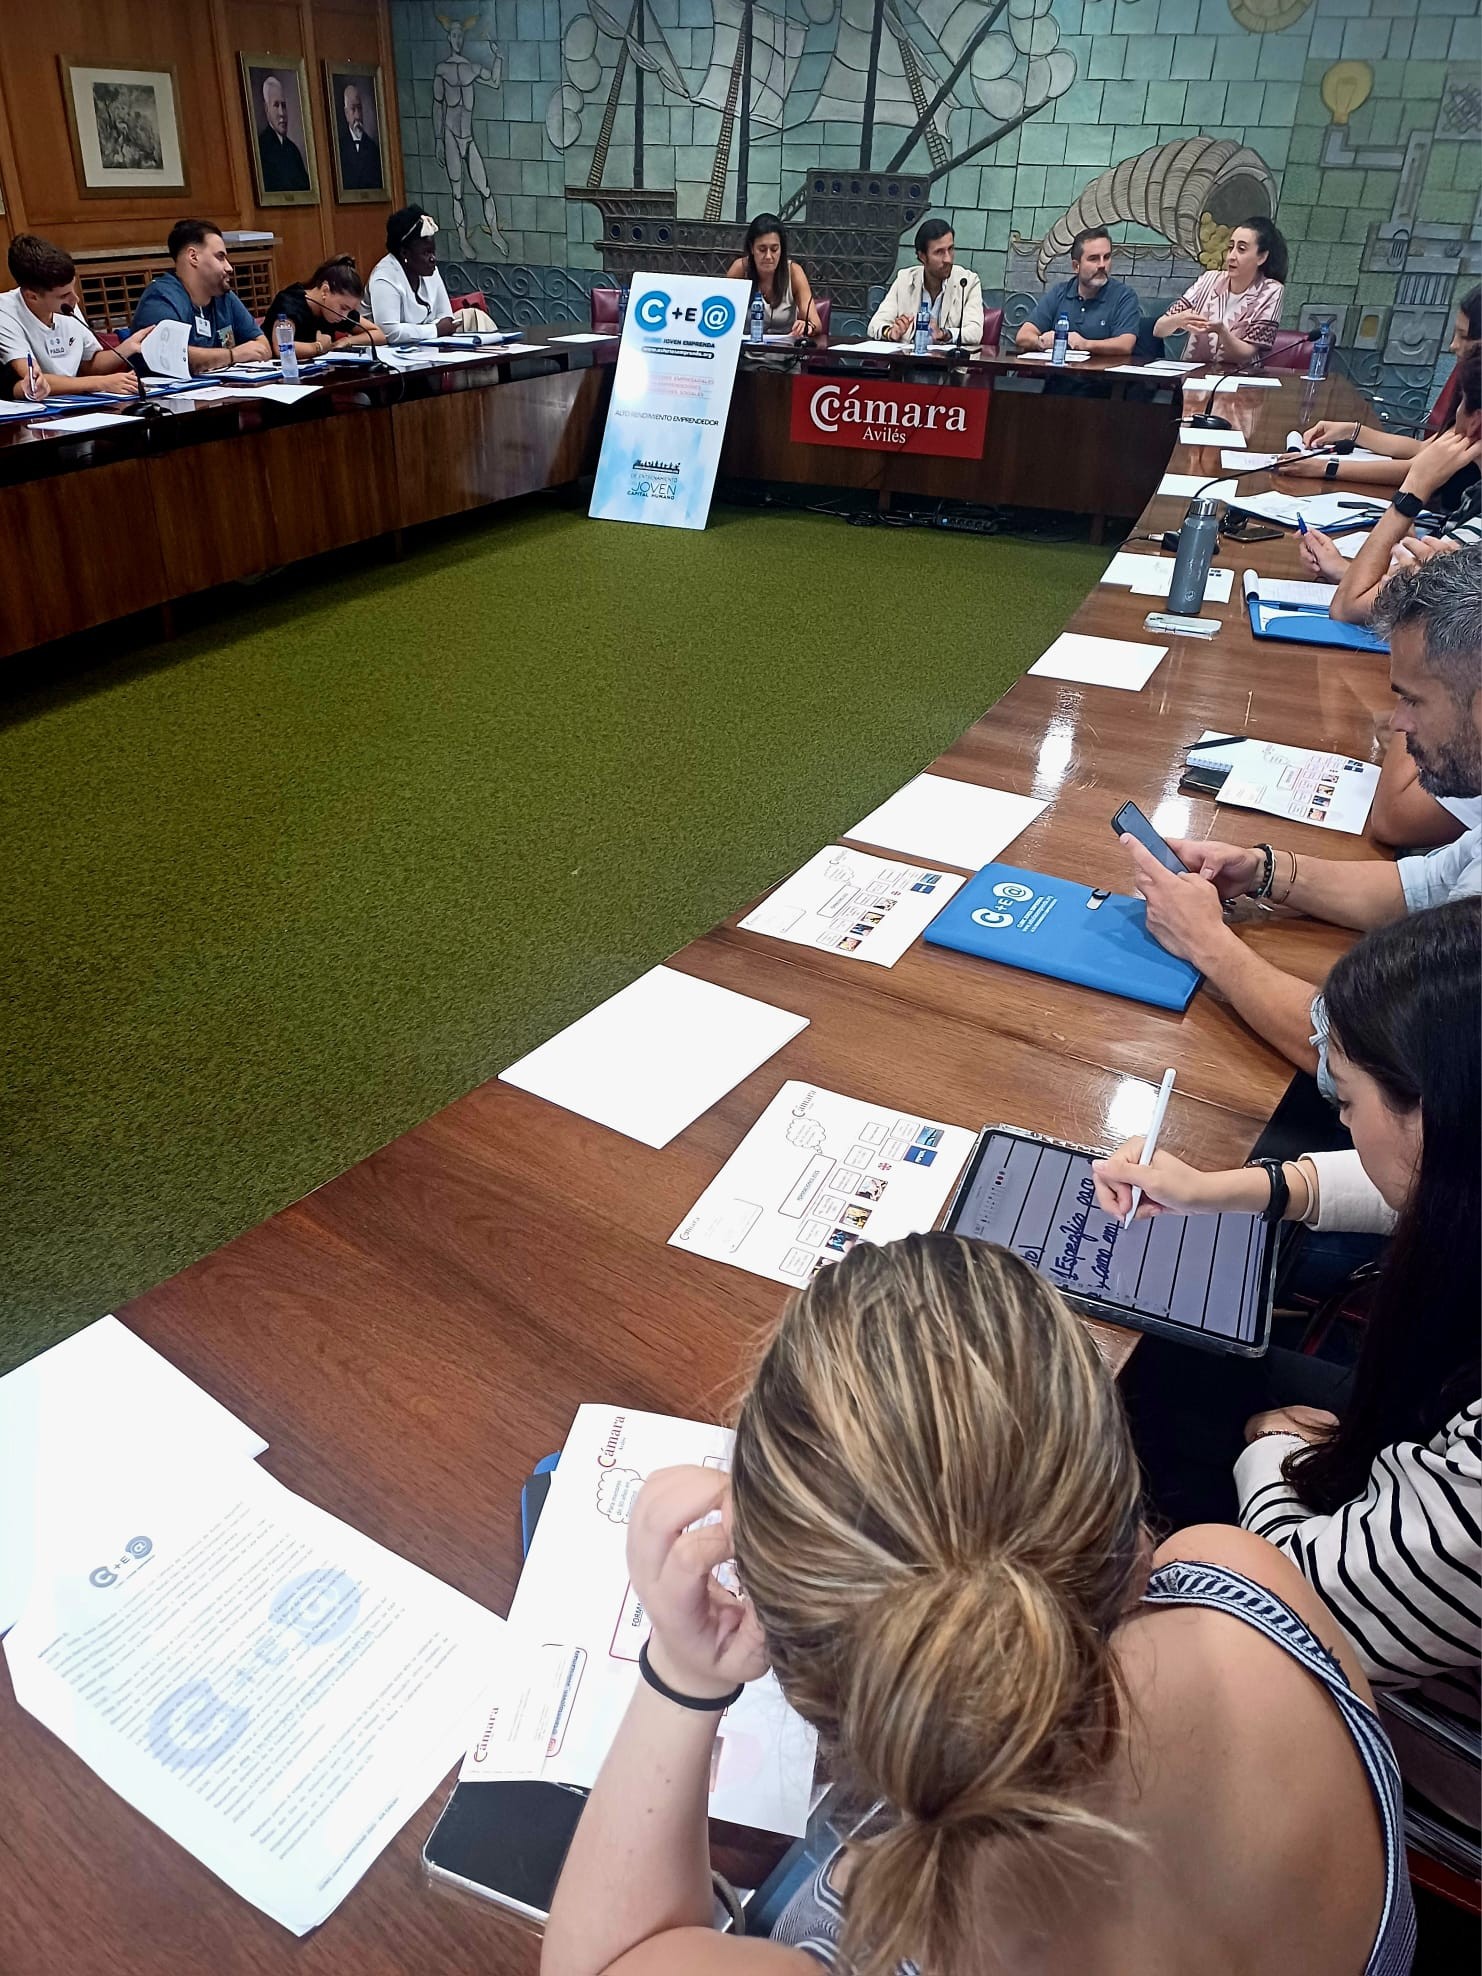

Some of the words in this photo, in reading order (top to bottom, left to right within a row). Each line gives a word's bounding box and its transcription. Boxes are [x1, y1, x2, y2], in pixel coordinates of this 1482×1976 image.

[672, 415, 720, 427] EMPRENDEDOR
[862, 426, 907, 444] Avilés
[627, 490, 649, 498] CAPITAL
[651, 493, 675, 501] HUMANO
[631, 481, 677, 496] JOVEN
[597, 1415, 626, 1467] Cámara
